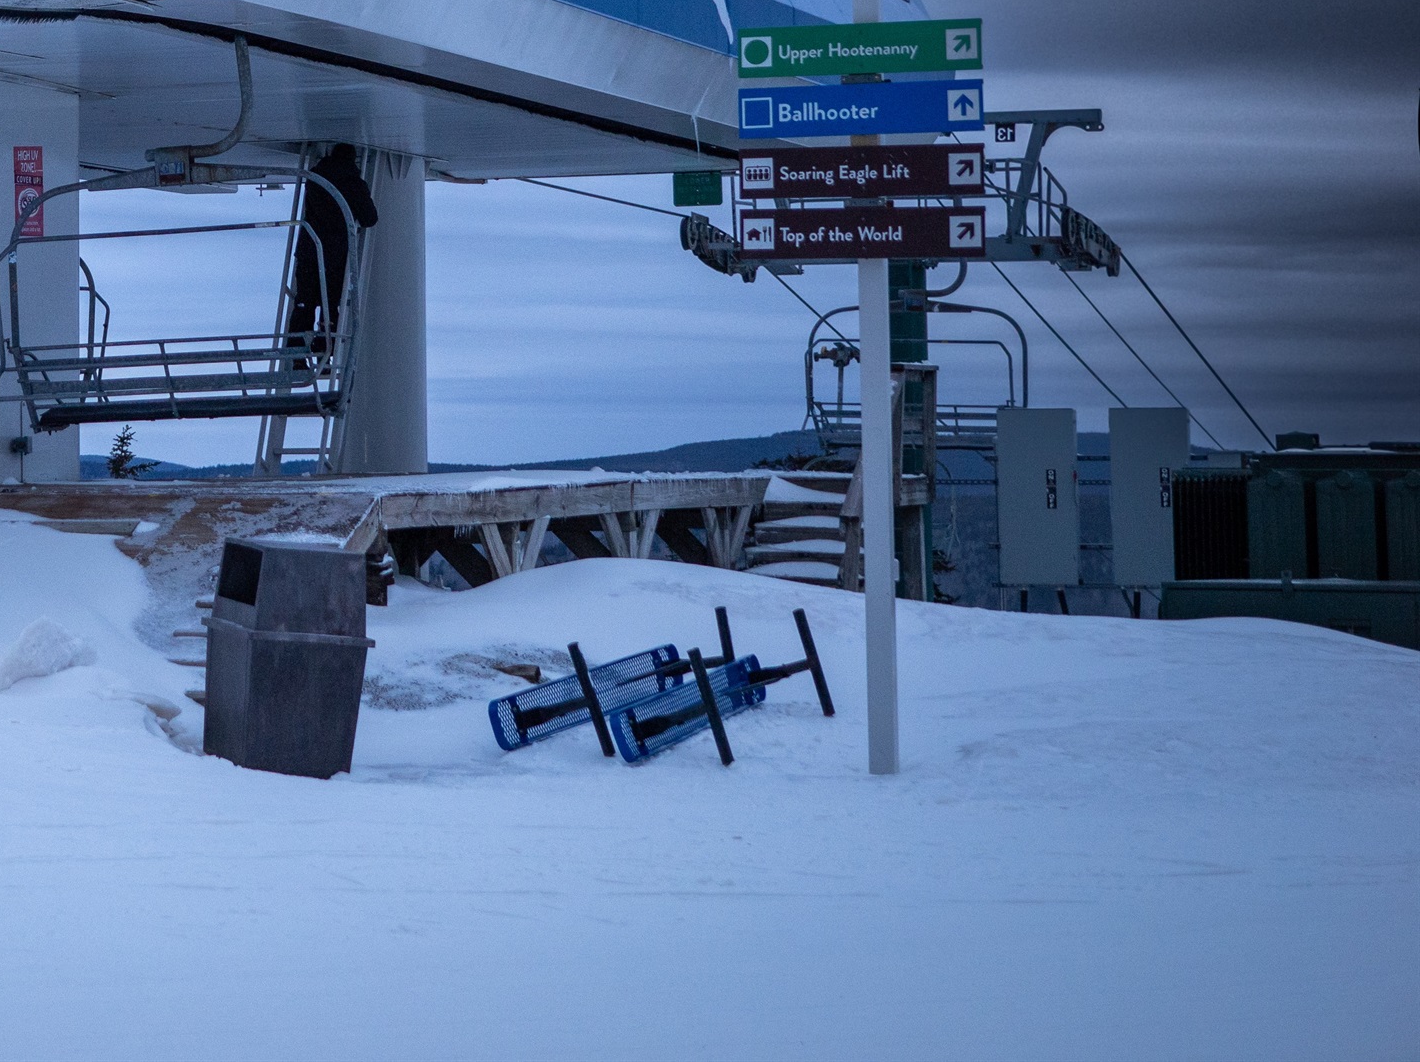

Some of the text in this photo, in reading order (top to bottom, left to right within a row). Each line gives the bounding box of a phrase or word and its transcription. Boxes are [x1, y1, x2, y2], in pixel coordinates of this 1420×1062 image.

[778, 42, 919, 65] Upper Hootenanny
[779, 103, 879, 123] Ballhooter
[17, 150, 38, 161] HIGH UV
[16, 175, 32, 184] COVER
[779, 164, 910, 185] Soaring Eagle Lift
[779, 225, 903, 247] Top of the World
